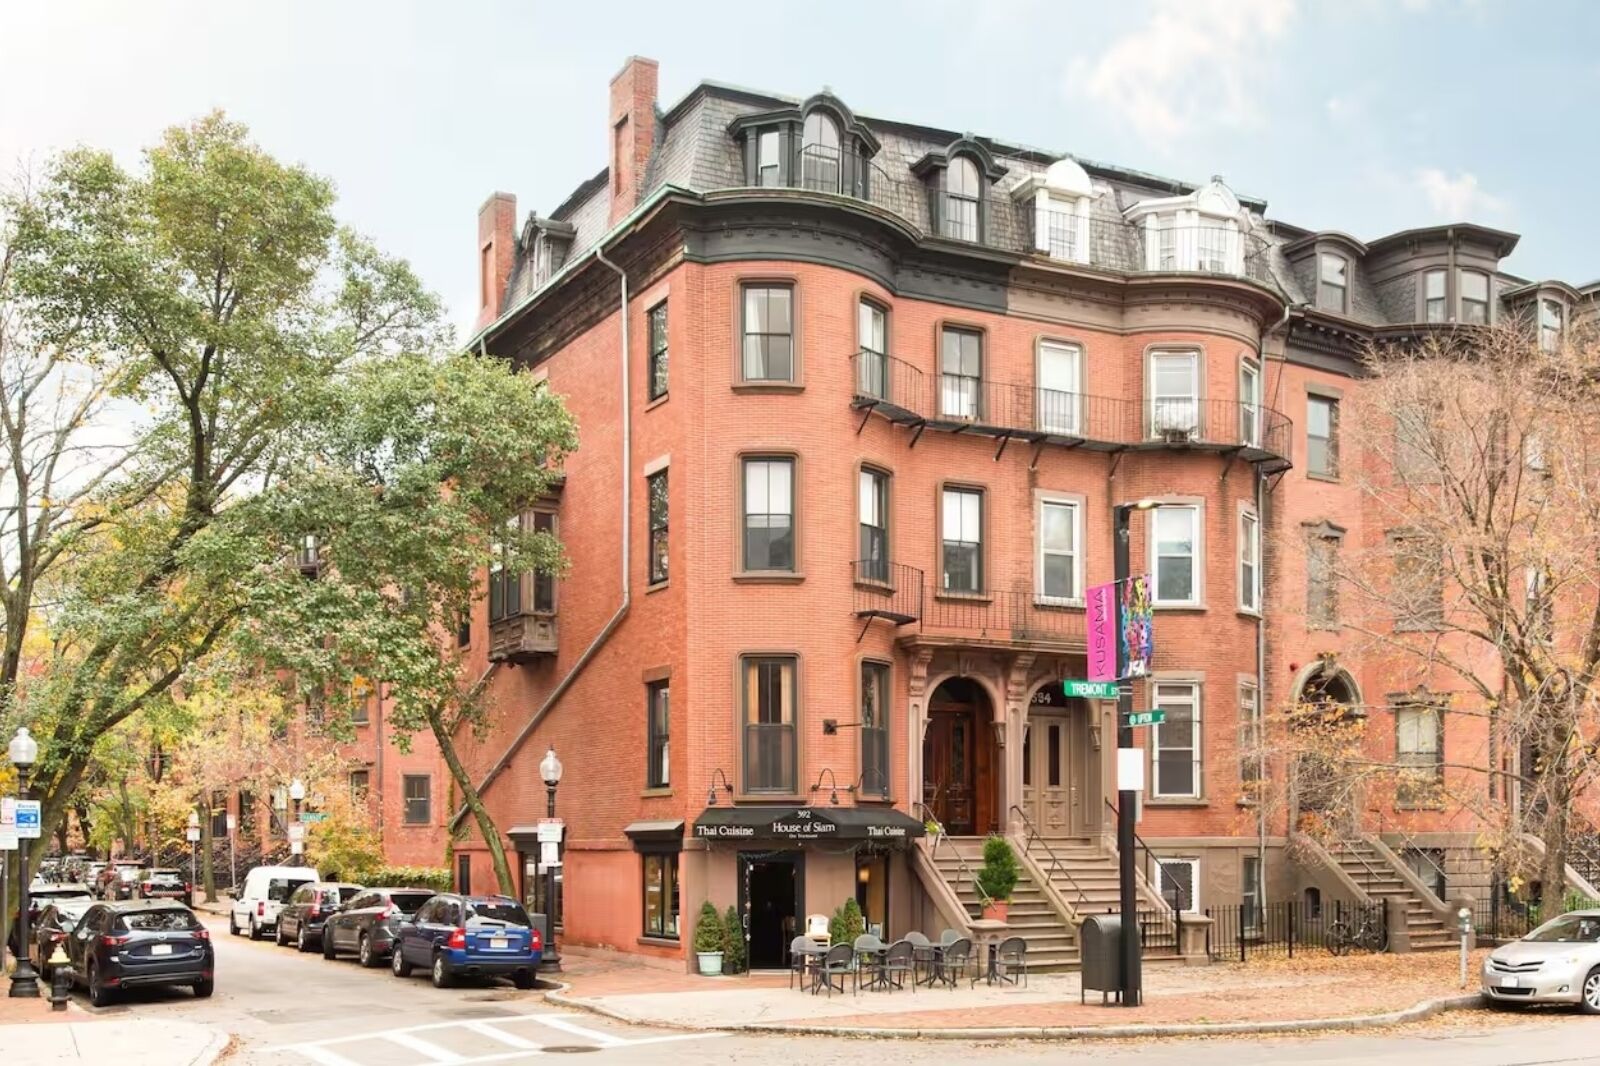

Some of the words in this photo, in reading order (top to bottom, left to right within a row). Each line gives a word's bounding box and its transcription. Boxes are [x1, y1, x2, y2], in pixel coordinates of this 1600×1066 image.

[1094, 588, 1106, 677] KUSAMA
[1071, 683, 1107, 696] TREMONT
[696, 825, 717, 836] Thai
[719, 825, 754, 836] Cuisine
[772, 822, 801, 833] House
[802, 821, 812, 832] of
[813, 821, 836, 833] Siam
[867, 825, 883, 836] Thai
[884, 825, 906, 836] Cuisine
